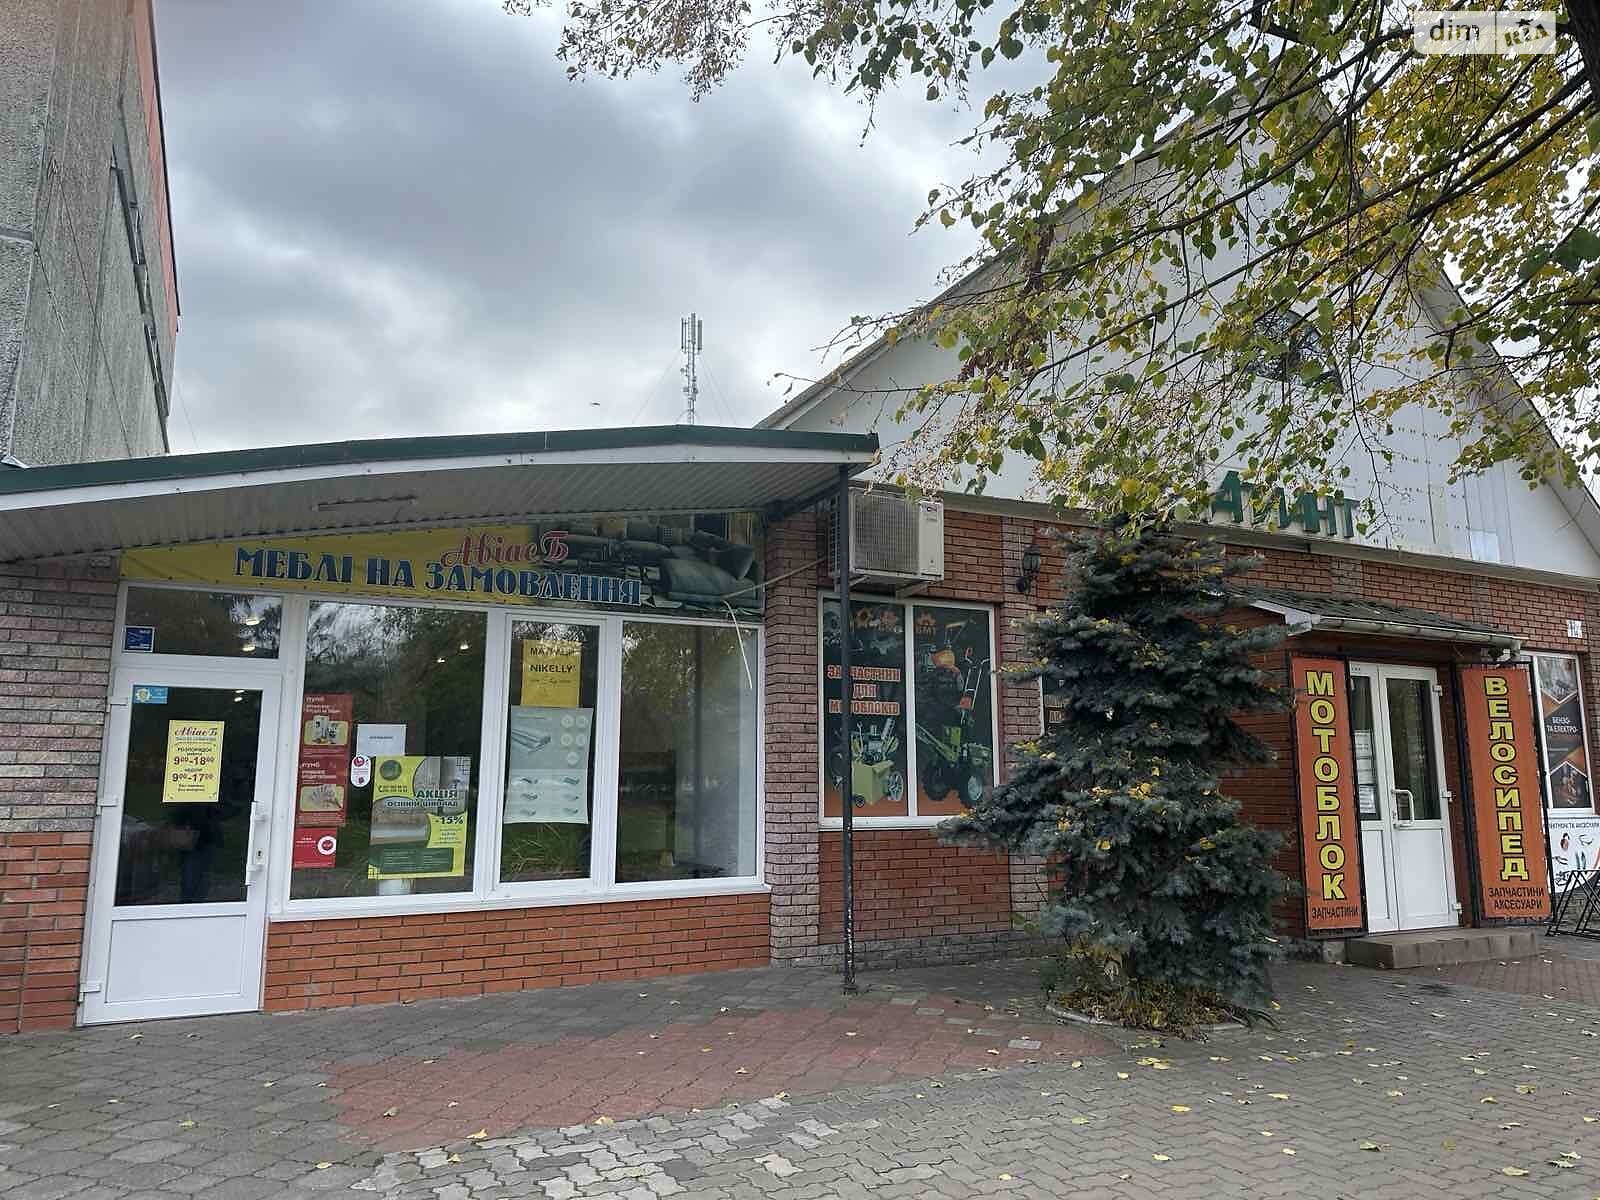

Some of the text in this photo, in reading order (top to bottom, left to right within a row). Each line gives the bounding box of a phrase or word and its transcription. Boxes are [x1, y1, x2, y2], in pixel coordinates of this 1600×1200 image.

[234, 546, 643, 606] МЕБЛІ НА ЗАМОВЛЕННЯ
[826, 665, 901, 682] ЗАЧАСТИНИ
[1305, 671, 1346, 900] МОТОБЛОК
[1484, 675, 1530, 882] ВЕЛОСИПЕД
[435, 815, 465, 825] -15%
[1488, 886, 1545, 899] ЗАПЧАСТИНИ
[1494, 898, 1543, 911] АКСЕСУАРИ
[1311, 906, 1360, 920] ЗАПЧАСТИНИ
